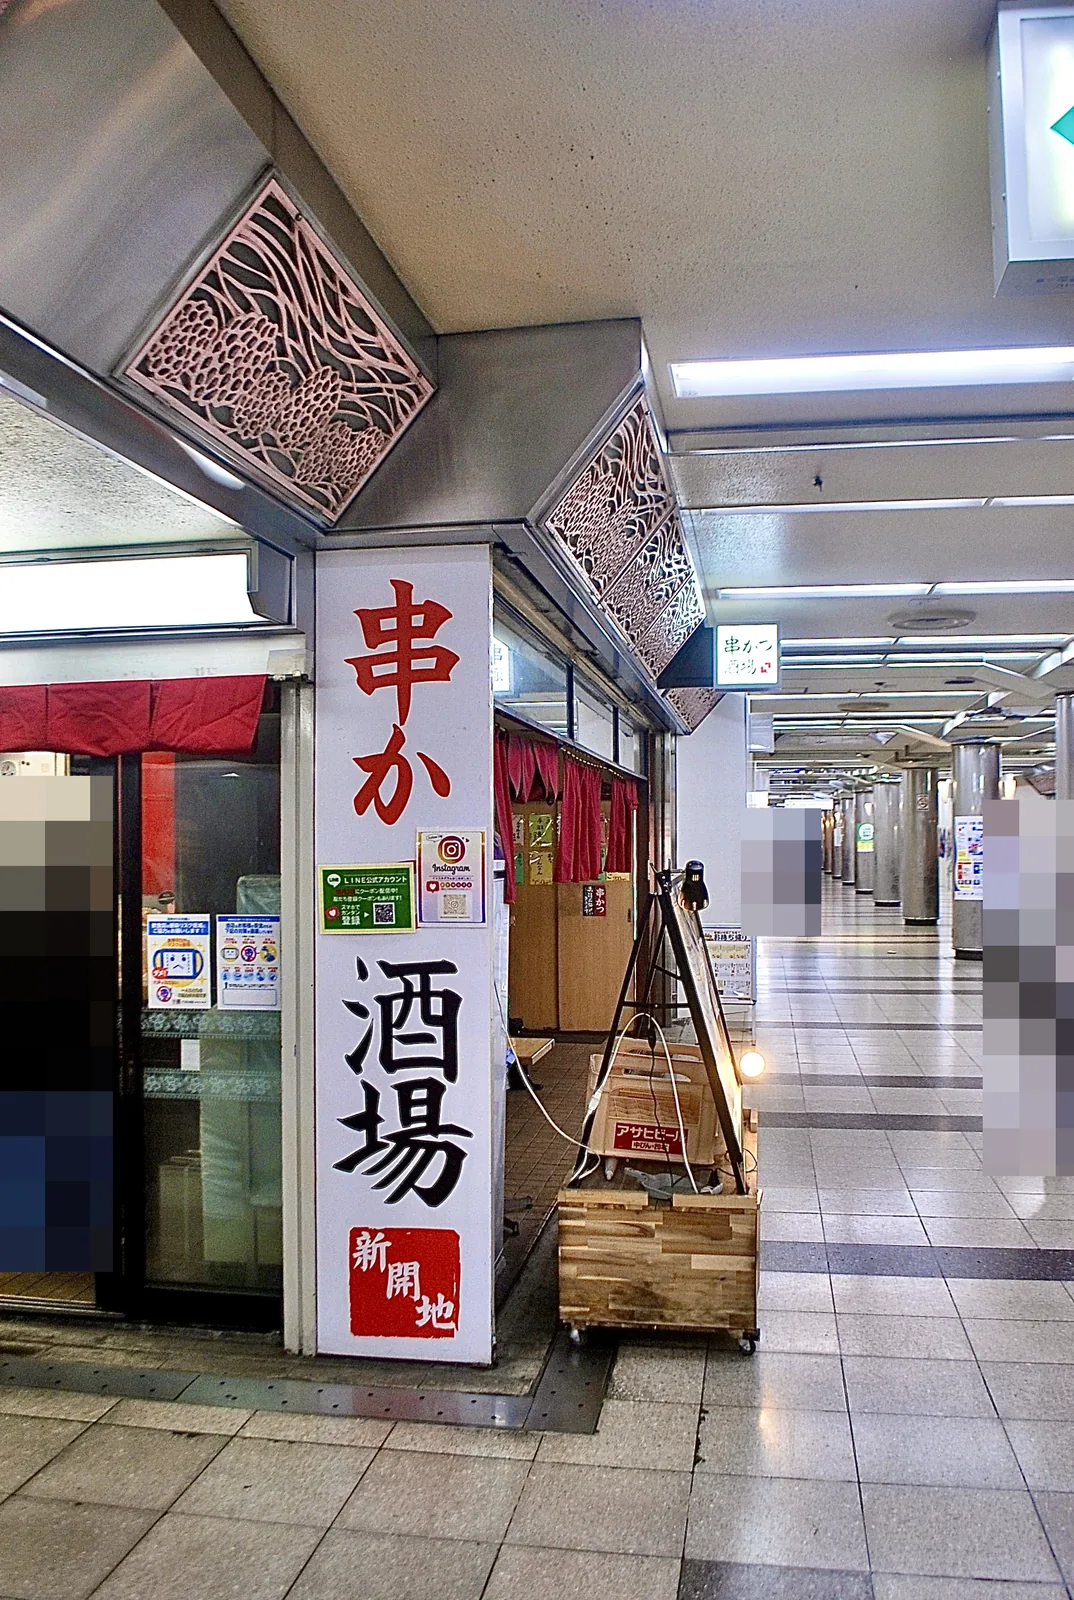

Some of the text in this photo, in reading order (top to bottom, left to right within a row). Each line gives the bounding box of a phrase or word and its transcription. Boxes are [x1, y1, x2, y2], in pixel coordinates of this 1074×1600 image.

[724, 636, 773, 656] 串かつ
[343, 579, 461, 929] 串か
[344, 876, 408, 884] LINE公式アカウント
[432, 863, 471, 875] Instagram
[595, 887, 605, 913] 串かつ
[332, 955, 474, 1209] 酒場
[352, 1231, 456, 1330] 新開地
